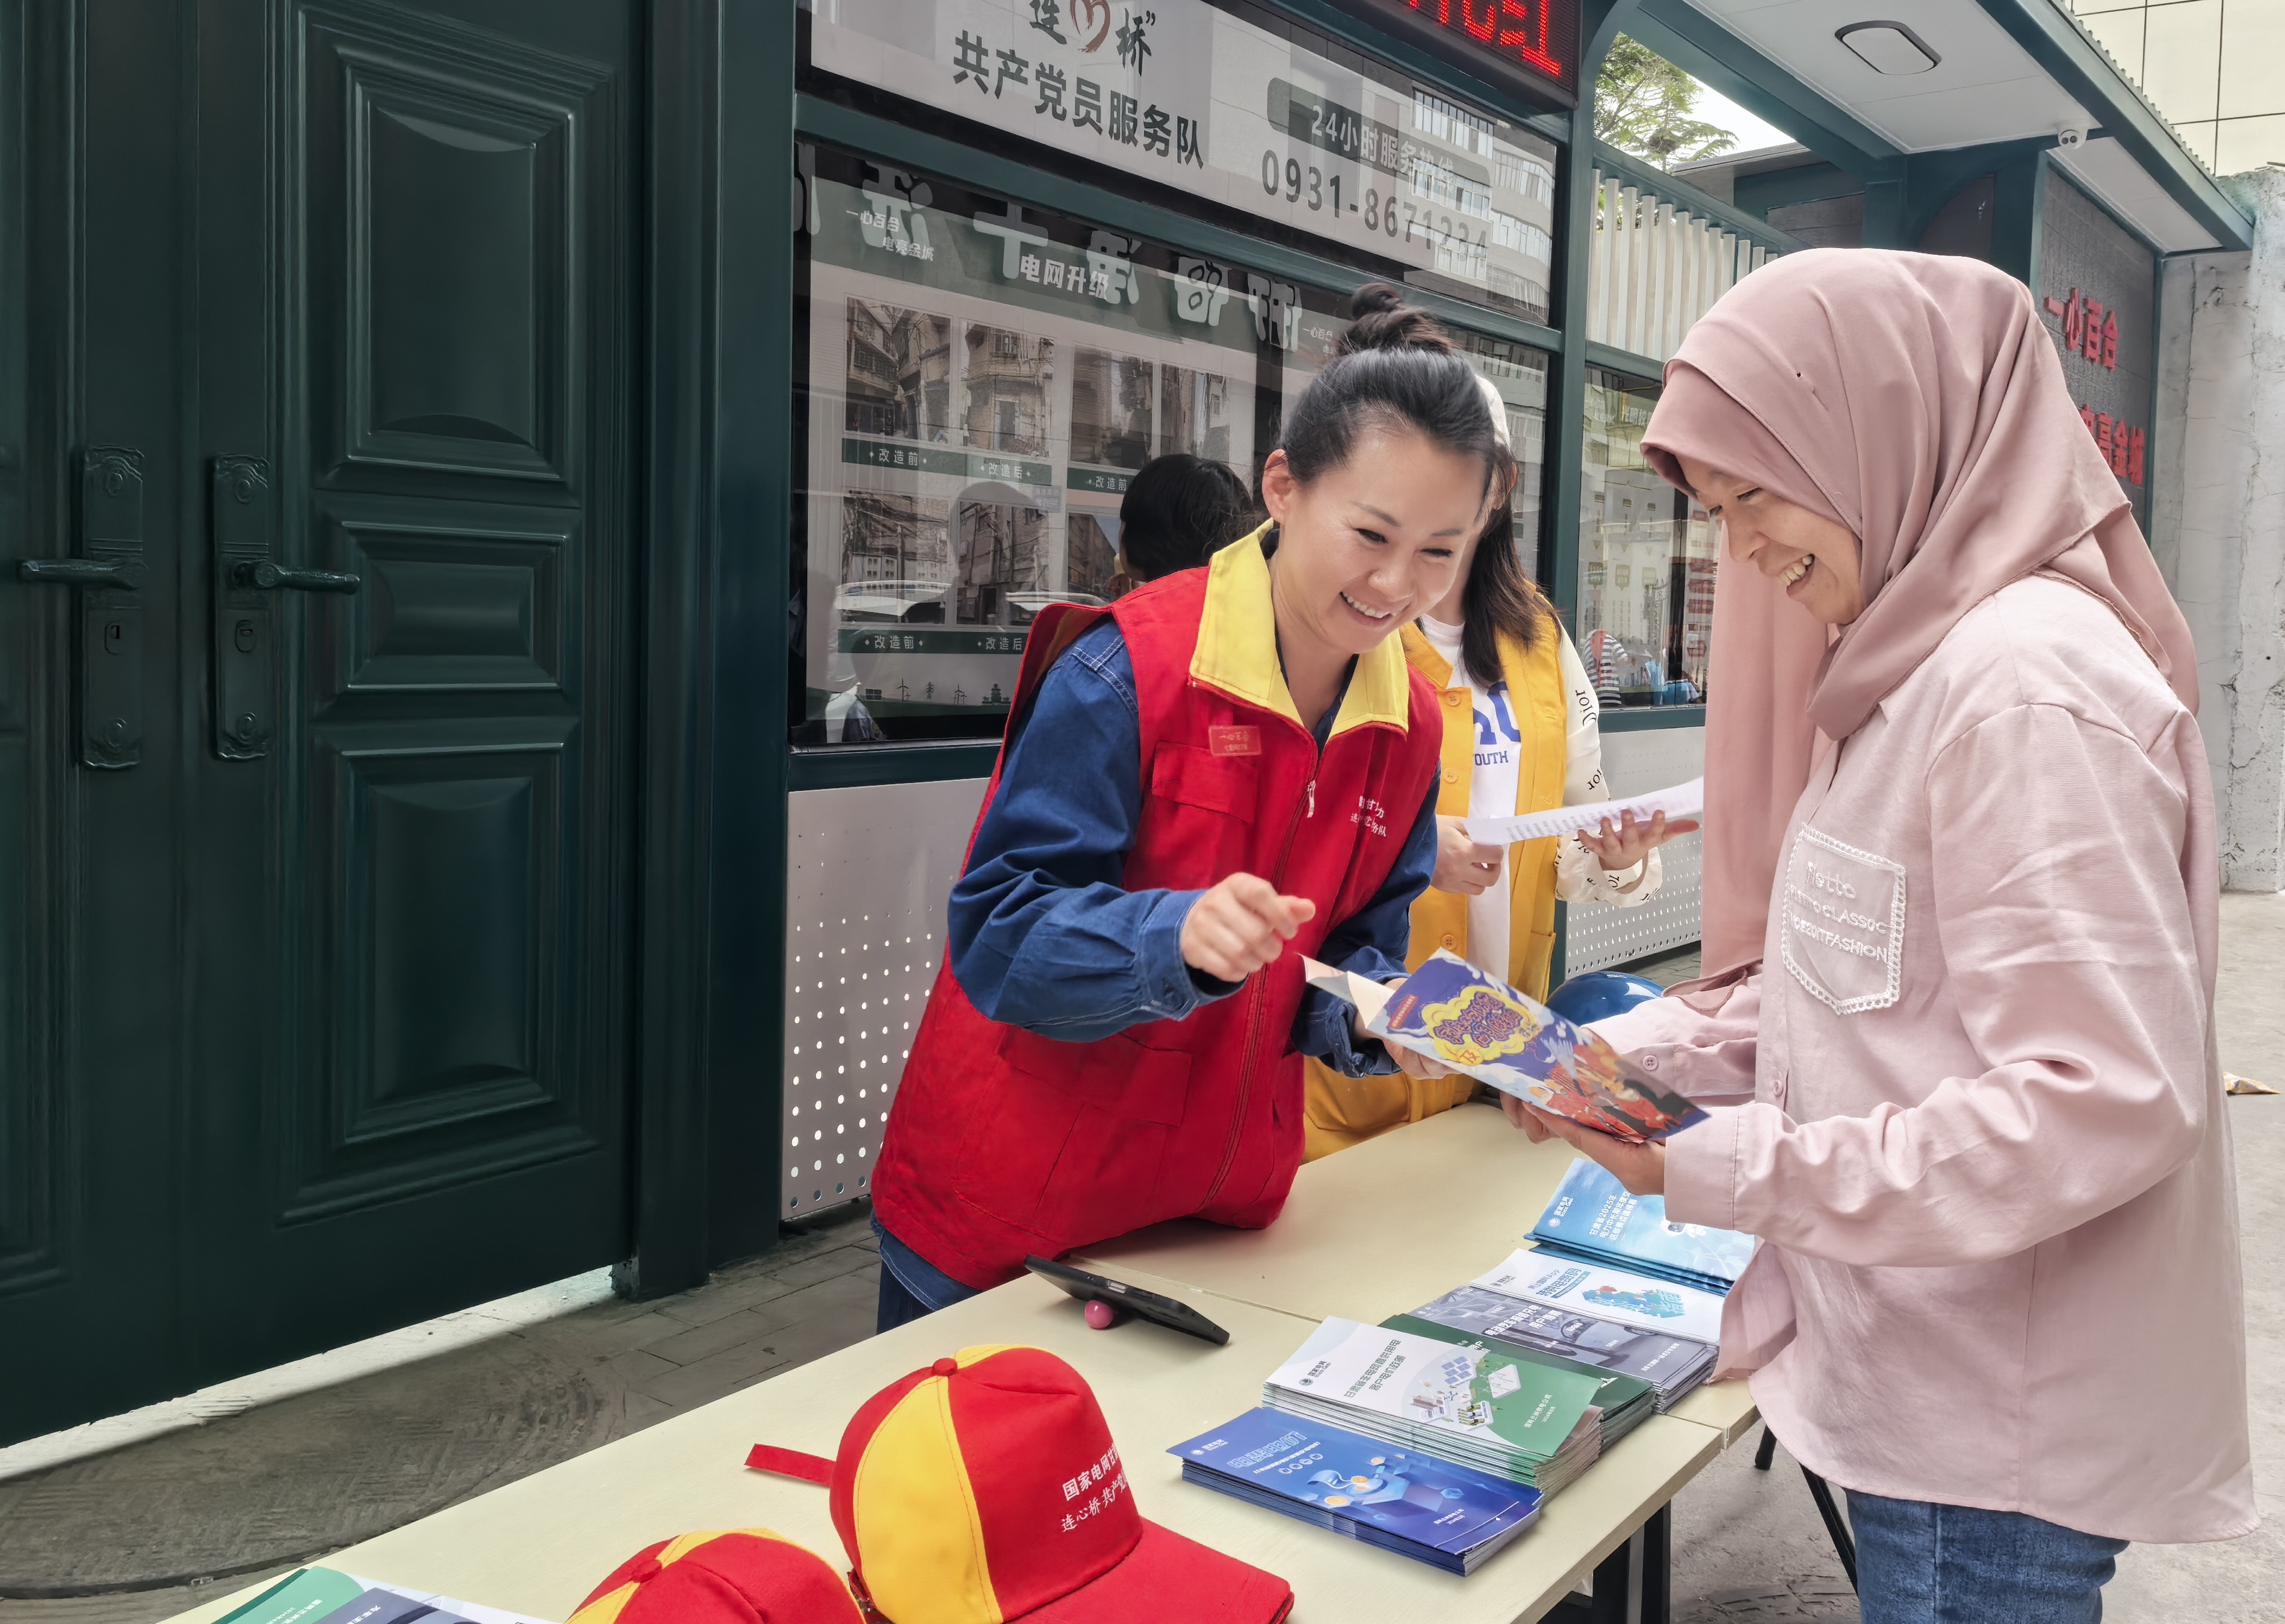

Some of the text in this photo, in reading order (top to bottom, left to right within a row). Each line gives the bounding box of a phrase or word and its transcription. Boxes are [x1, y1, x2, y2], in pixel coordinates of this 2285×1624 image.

[953, 30, 1204, 170] 共产党员服务队
[1262, 150, 1486, 260] 0931-8671234
[846, 209, 900, 232] 一心百合
[883, 235, 935, 261] 电亮金城
[1020, 253, 1110, 300] 电网升级
[2044, 287, 2119, 372] 一心百合
[879, 448, 919, 466] 改造前
[988, 462, 1022, 479] 改造后
[1095, 476, 1127, 491] 改造前
[874, 635, 915, 649] 改造前
[985, 637, 1022, 650] 改造后
[1472, 751, 1509, 766] OUTH
[1061, 1497, 1101, 1532] 连心桥
